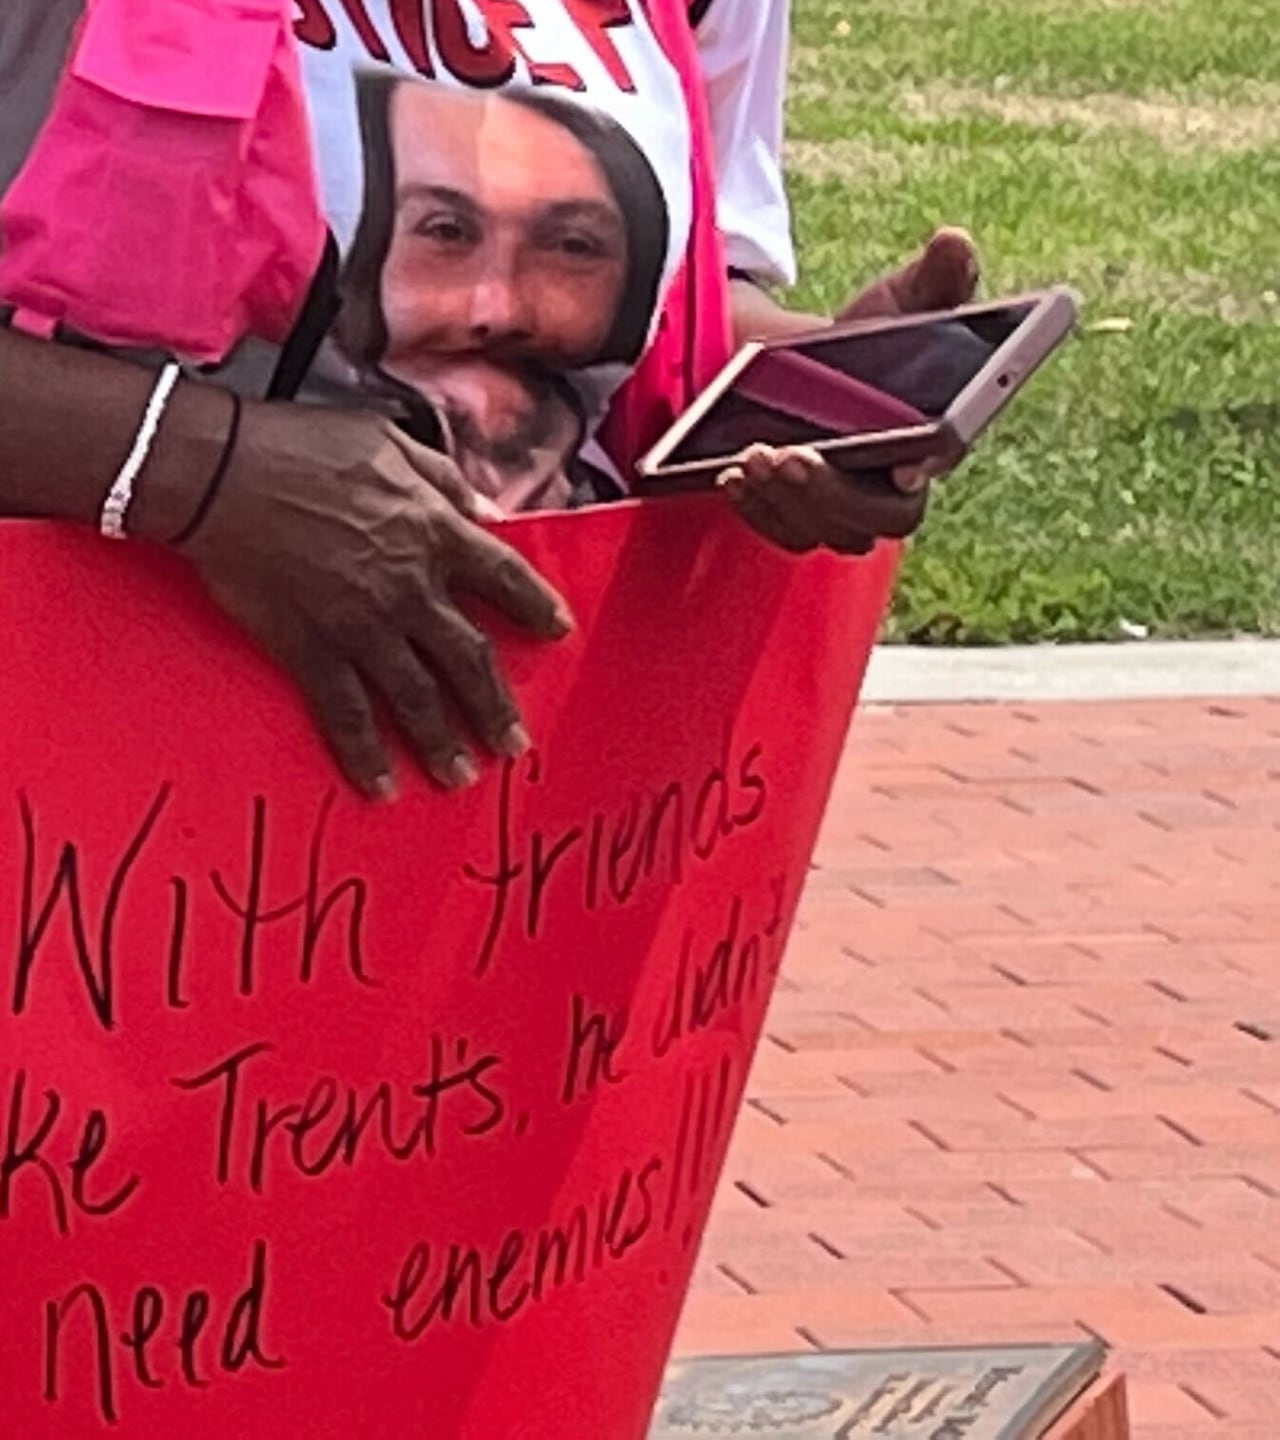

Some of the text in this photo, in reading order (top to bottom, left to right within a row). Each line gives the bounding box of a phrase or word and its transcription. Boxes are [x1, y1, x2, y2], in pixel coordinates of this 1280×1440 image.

[11, 742, 769, 1031] With friends
[559, 991, 630, 1105] he
[43, 1240, 285, 1423] need
